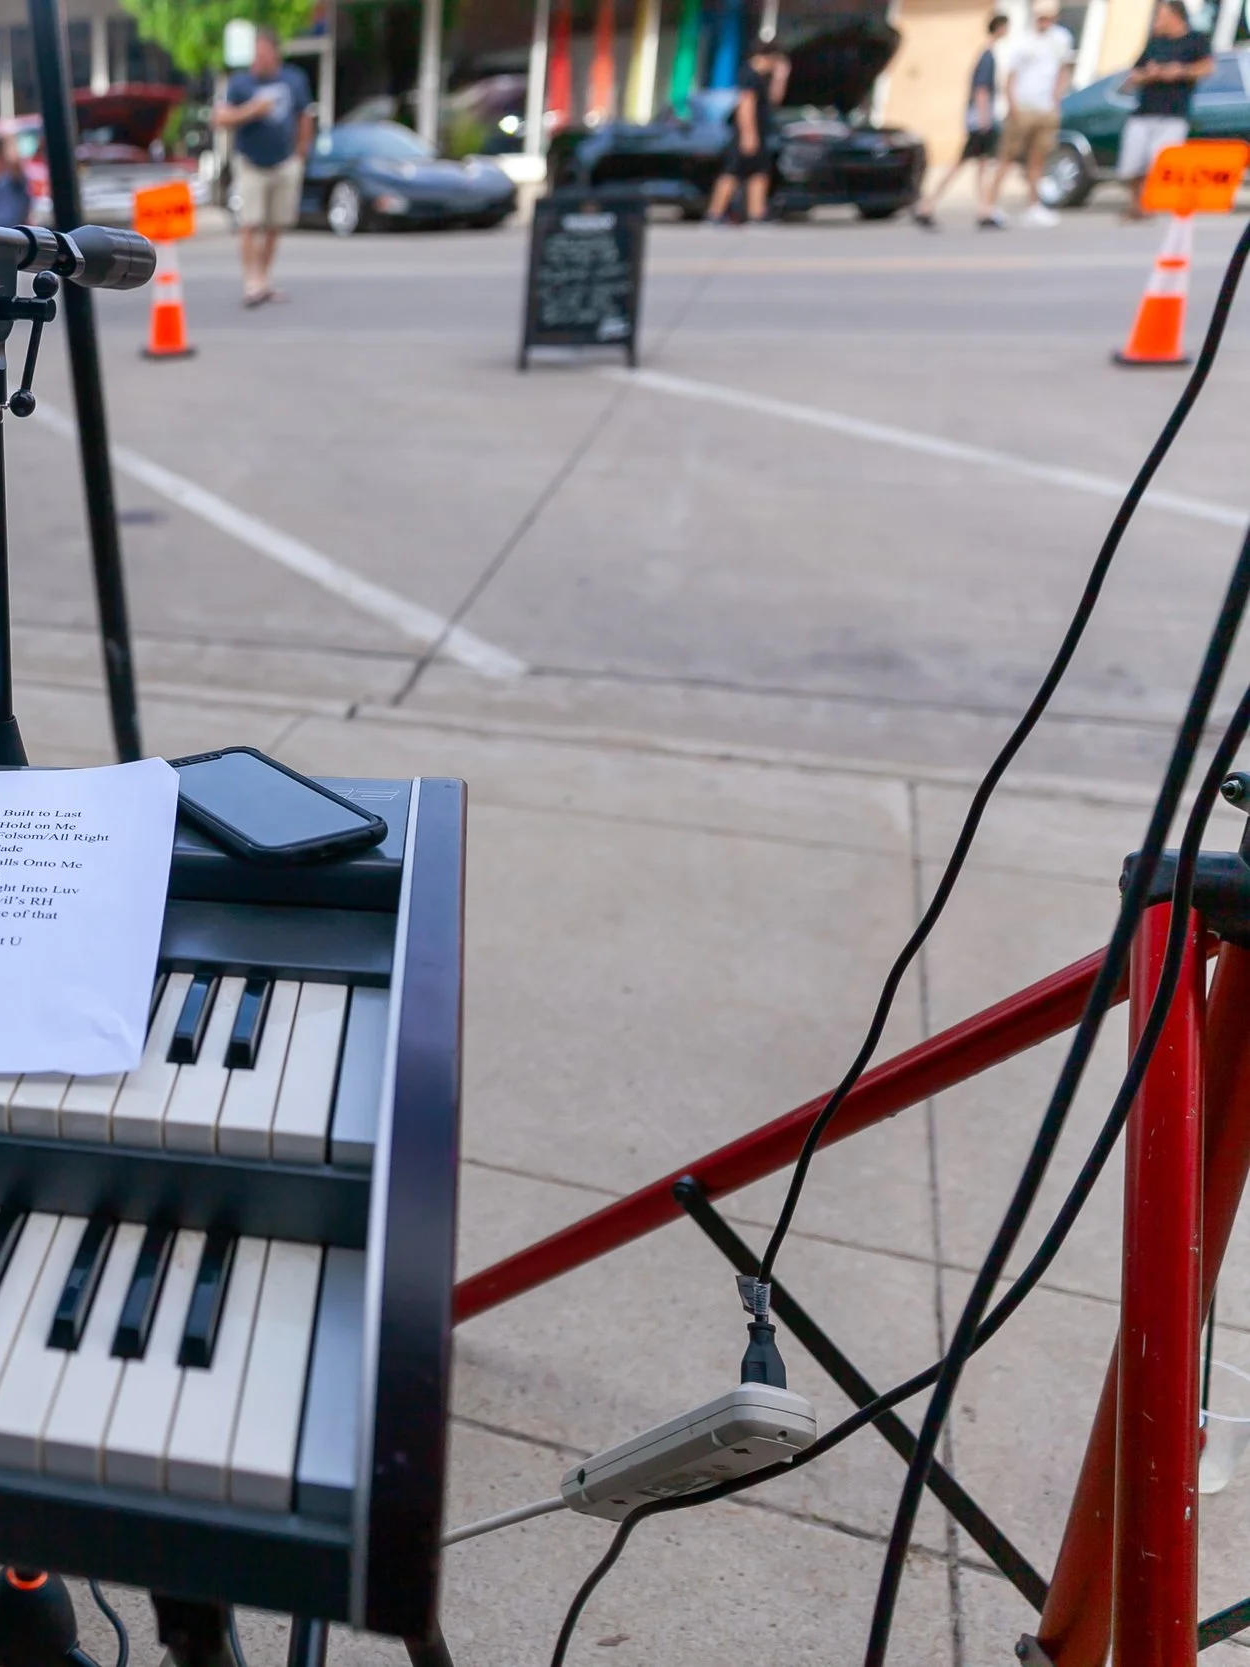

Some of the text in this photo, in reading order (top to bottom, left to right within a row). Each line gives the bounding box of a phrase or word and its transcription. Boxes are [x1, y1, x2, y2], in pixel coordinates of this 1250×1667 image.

[55, 810, 82, 818] Last
[74, 833, 110, 843] Right
[24, 859, 56, 868] Onto
[60, 861, 83, 869] Me
[21, 884, 48, 893] Into
[52, 886, 80, 894] Luv
[30, 897, 54, 906] RH
[13, 909, 30, 919] of
[32, 910, 58, 920] that
[10, 936, 22, 946] U
